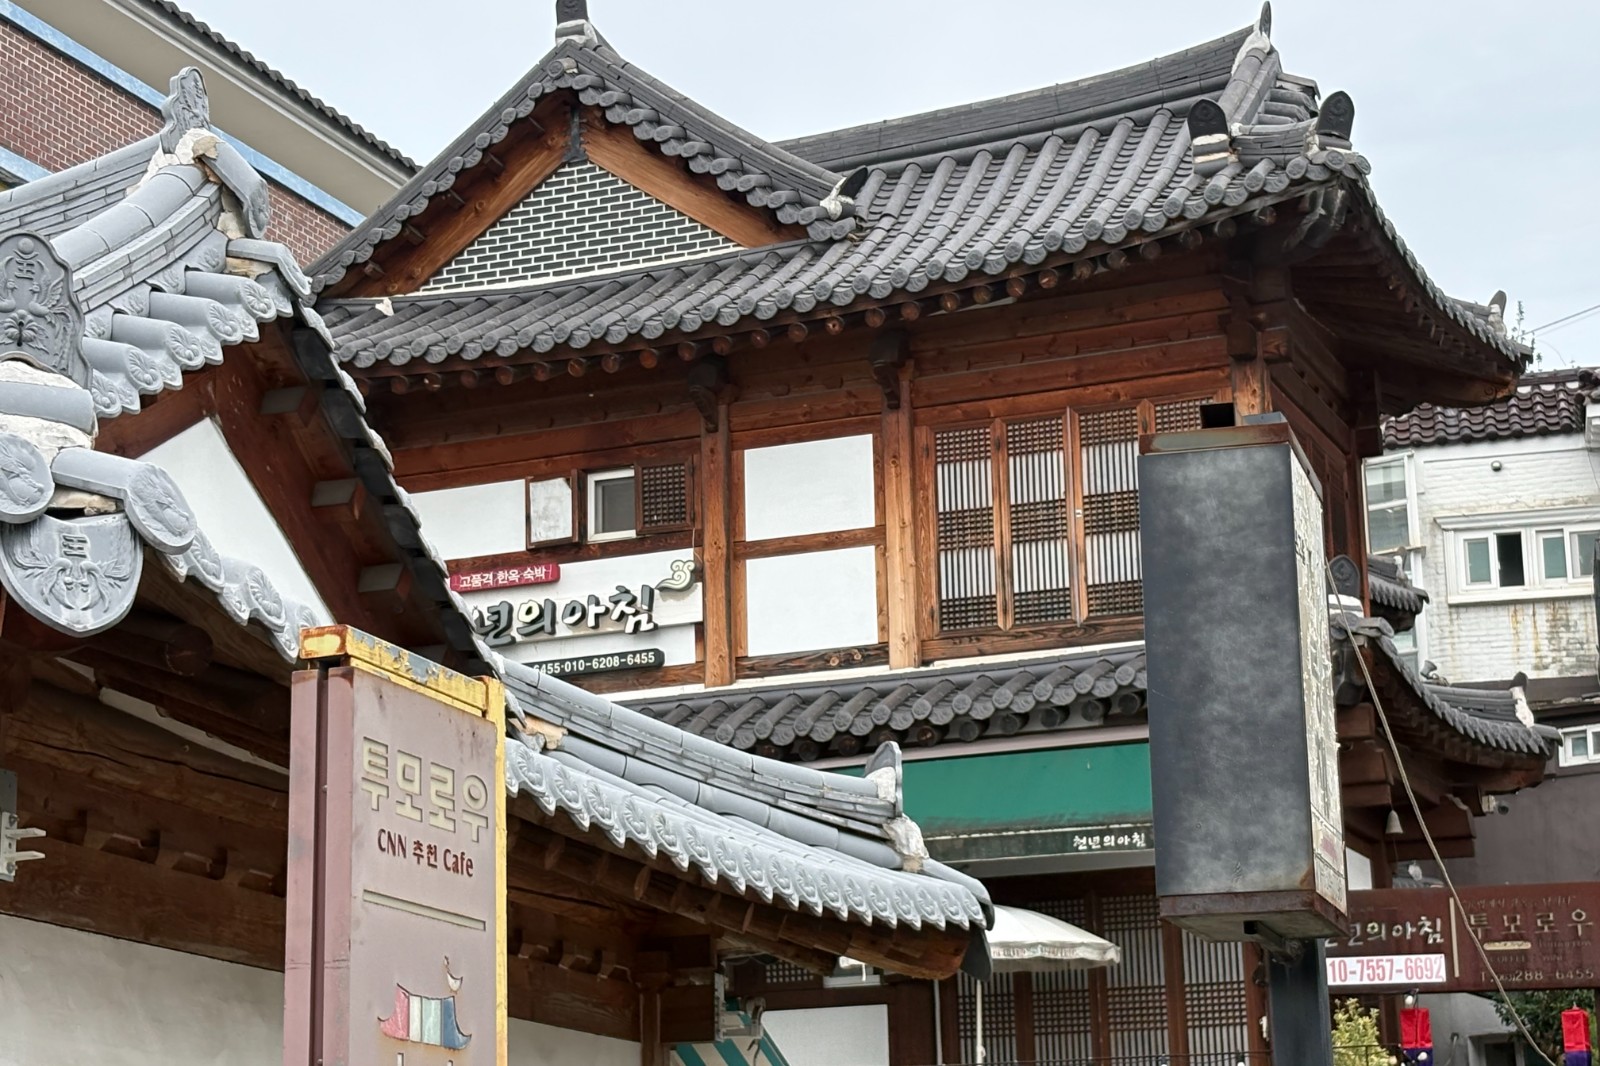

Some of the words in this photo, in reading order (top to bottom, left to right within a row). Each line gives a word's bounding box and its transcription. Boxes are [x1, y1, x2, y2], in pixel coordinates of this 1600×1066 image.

[459, 571, 493, 588] 고품격
[497, 569, 520, 584] 한옥
[523, 566, 547, 581] 숙박
[361, 736, 489, 843] 투모로우
[377, 828, 407, 859] CNN
[412, 840, 438, 869] 추천
[443, 849, 474, 877] Cafe
[1469, 908, 1594, 940] 투모로우
[1328, 957, 1445, 983] 10-7557-6692
